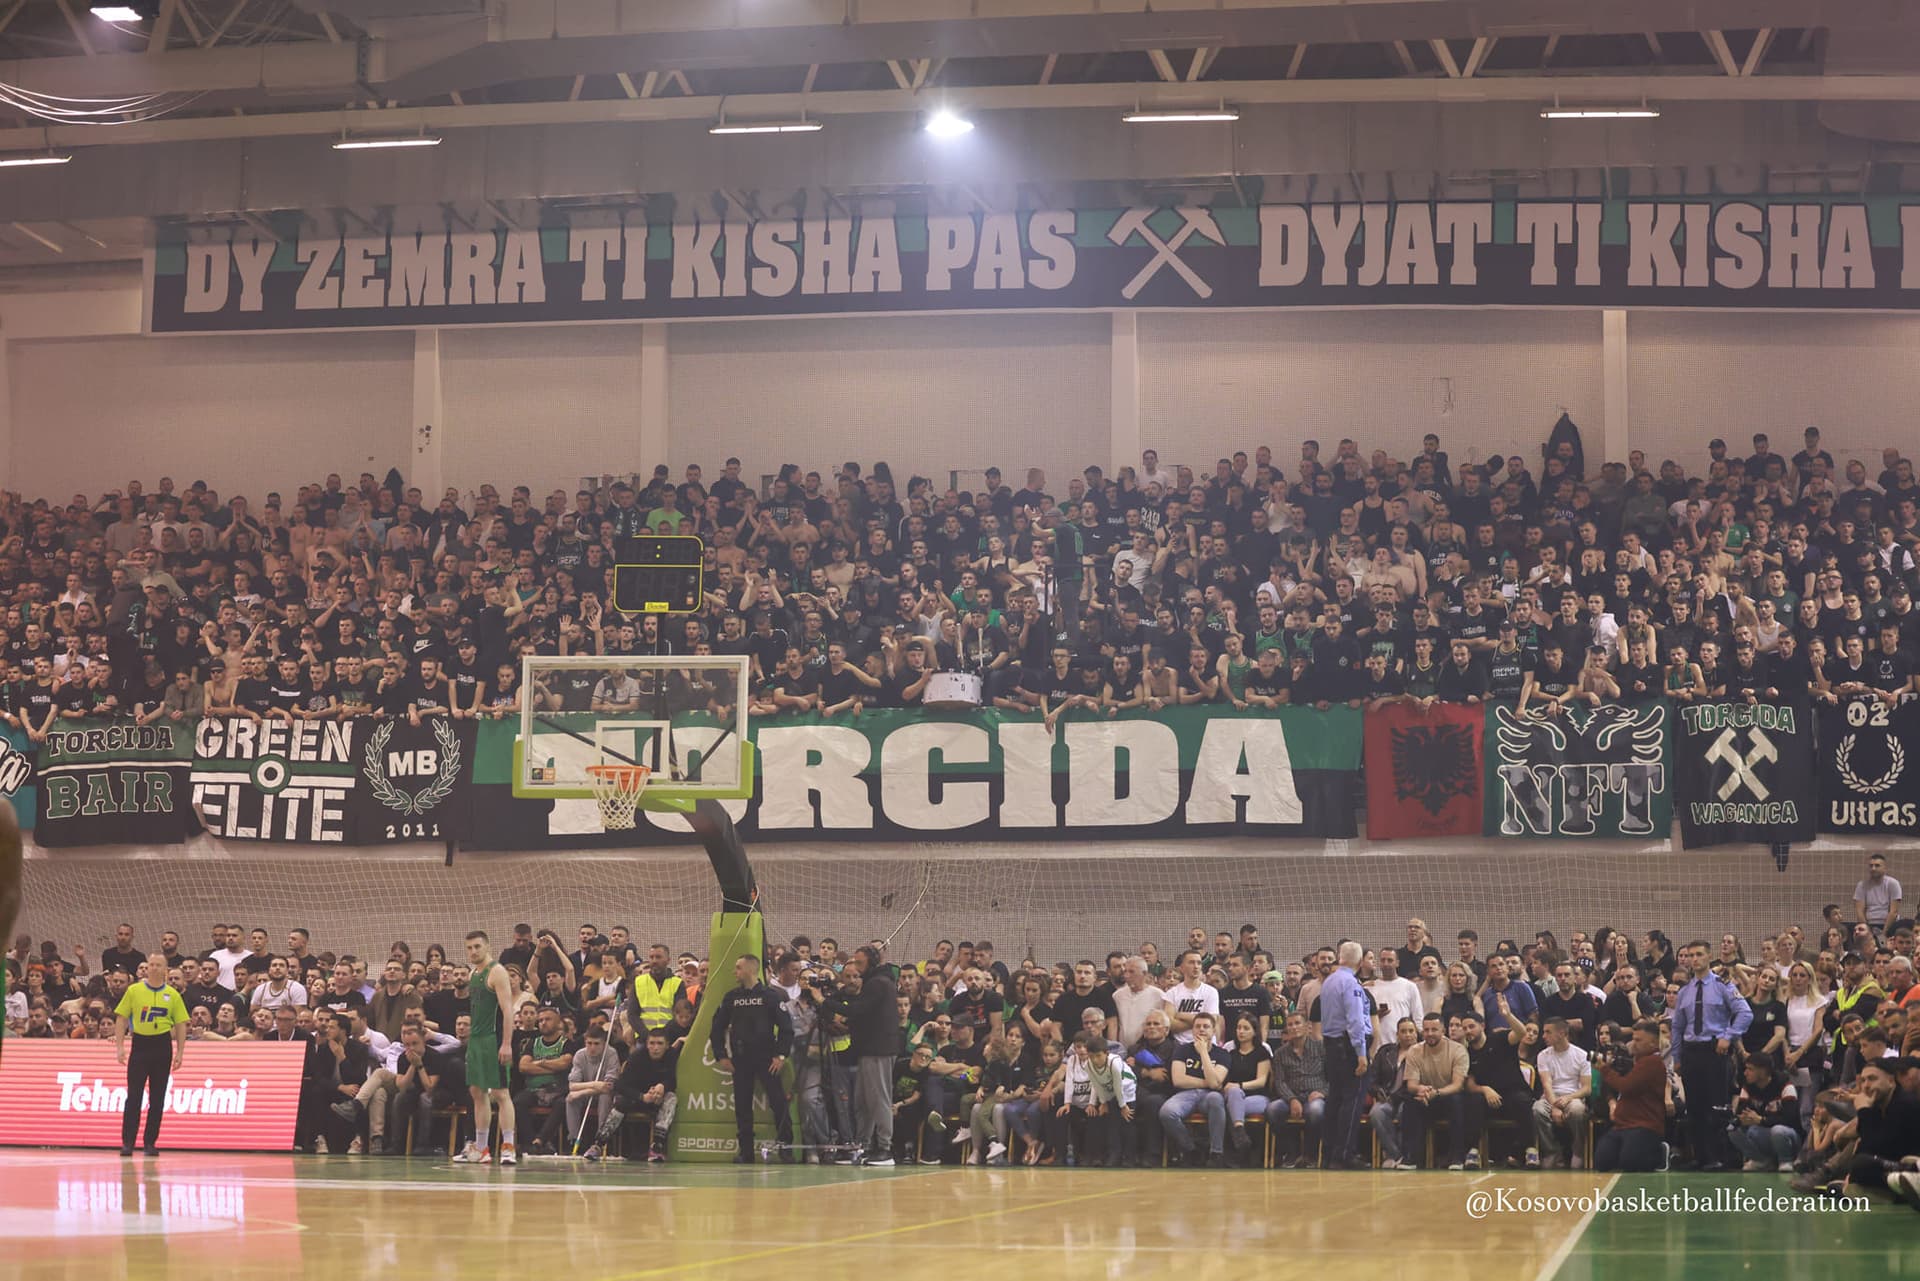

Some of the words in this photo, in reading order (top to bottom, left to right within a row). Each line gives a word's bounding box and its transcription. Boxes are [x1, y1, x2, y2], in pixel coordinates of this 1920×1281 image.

[184, 237, 278, 314] DY
[295, 228, 547, 311] ZEMRA
[568, 222, 648, 302] TI
[671, 212, 903, 299] KISHA
[925, 207, 1078, 291] PAS
[1258, 202, 1493, 287] DYJAT
[1516, 202, 1604, 287] TI
[1627, 202, 1877, 290] KISHA
[1681, 703, 1796, 736] TORCIDA
[1847, 701, 1889, 727] 02
[46, 726, 175, 757] TORCIDA
[195, 718, 354, 762] GREEN
[388, 750, 438, 777] MB
[532, 717, 1304, 836] TORCIDA
[47, 771, 174, 819] BAIR
[1497, 763, 1665, 835] NFT
[192, 784, 345, 841] ELITE
[1689, 800, 1799, 825] WAGANICA
[1832, 800, 1918, 827] Ultras
[386, 823, 439, 838] 2011
[733, 998, 763, 1007] POLICE
[1178, 998, 1205, 1013] NIKE
[687, 1092, 767, 1110] MISSN
